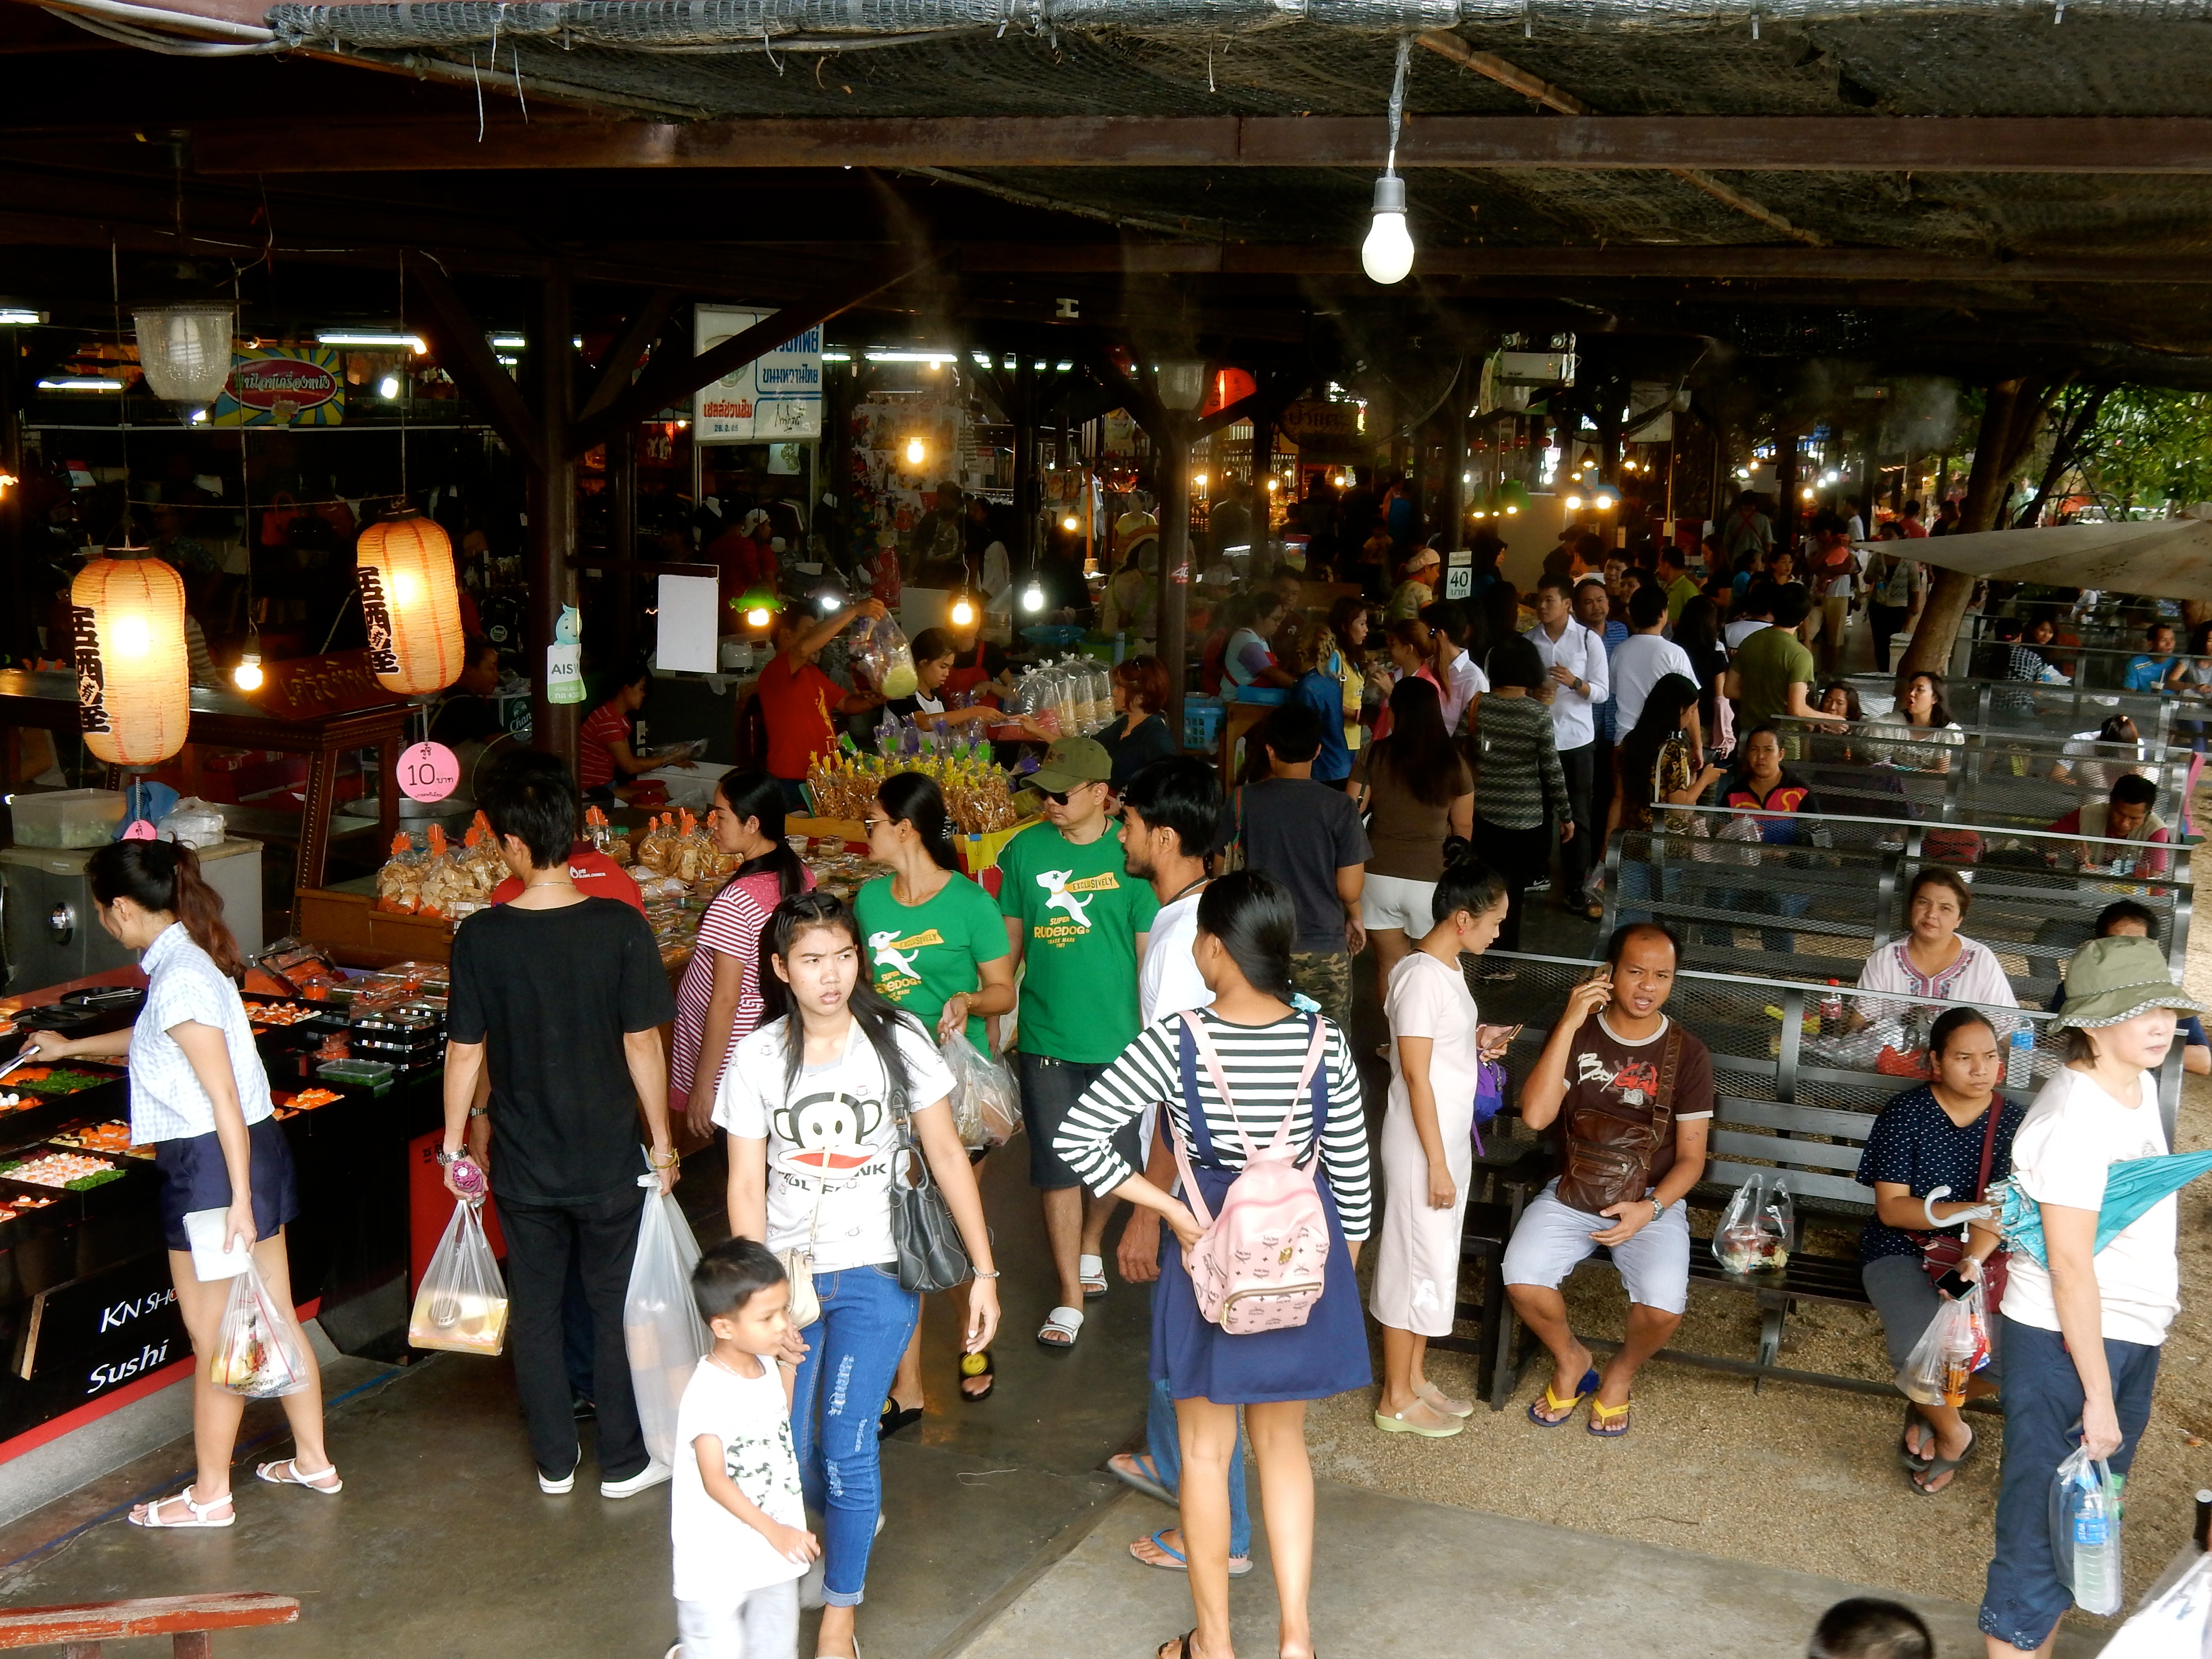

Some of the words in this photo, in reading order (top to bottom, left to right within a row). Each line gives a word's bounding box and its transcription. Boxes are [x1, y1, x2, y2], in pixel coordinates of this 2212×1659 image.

[703, 399, 753, 419] เชลล์ชวนชิม
[1450, 571, 1468, 587] 40
[510, 712, 532, 733] Chan
[408, 763, 435, 786] 10
[1072, 877, 1113, 891] EXCLUSIVELY
[1049, 916, 1070, 926] SUPER
[821, 1163, 887, 1194] FNK
[100, 1298, 142, 1333] KN
[144, 1288, 178, 1314] SHO
[87, 1339, 169, 1394] Sushi
